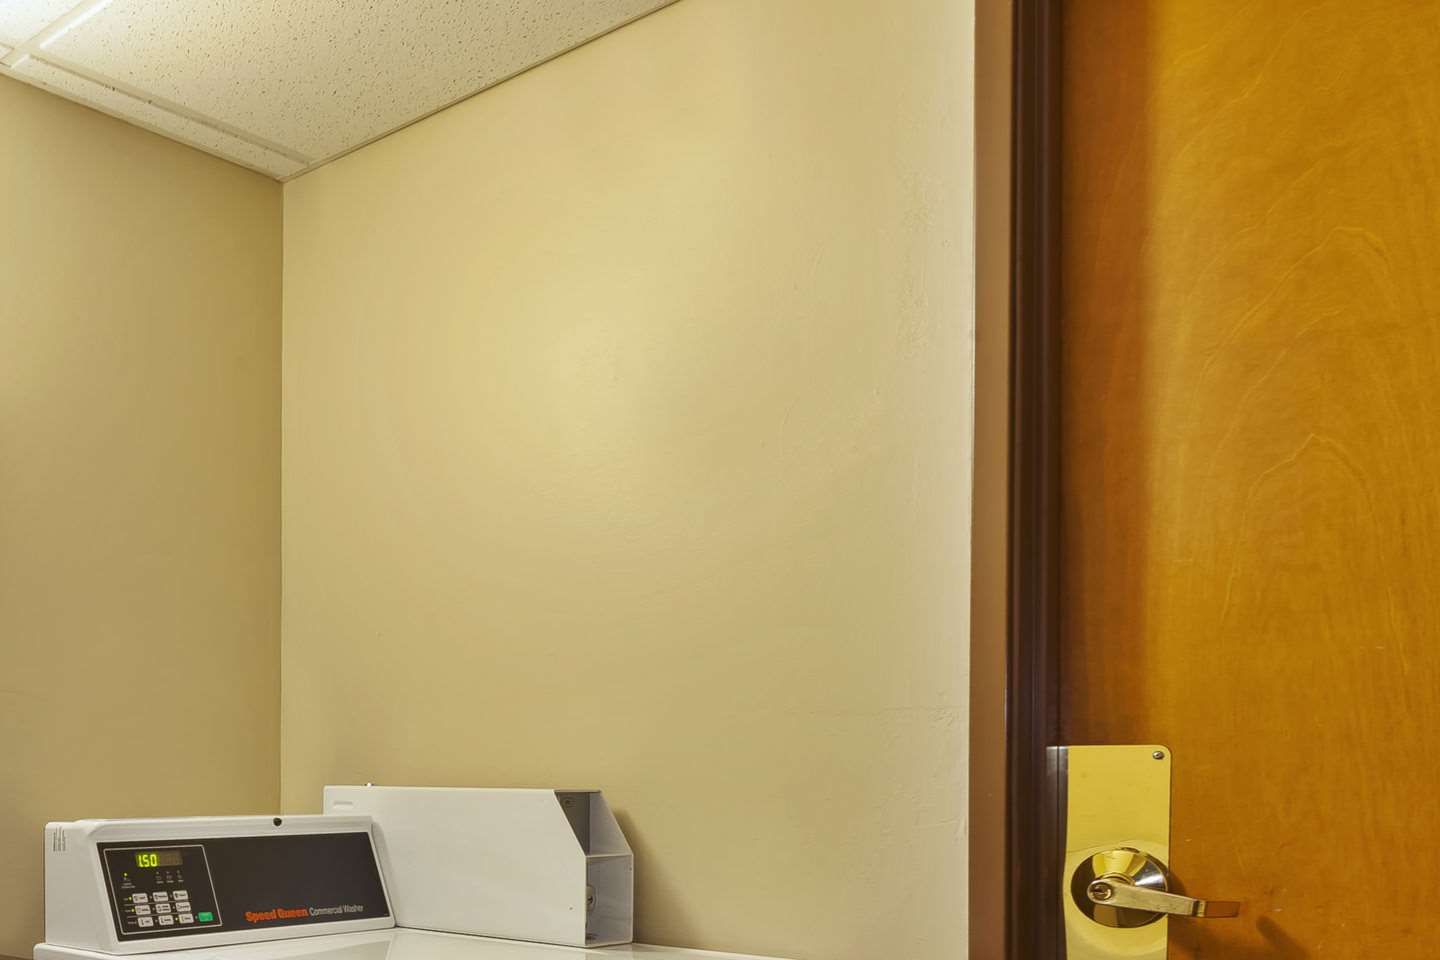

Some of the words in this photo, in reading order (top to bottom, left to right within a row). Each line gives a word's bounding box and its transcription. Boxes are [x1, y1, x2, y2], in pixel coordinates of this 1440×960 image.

[245, 909, 277, 923] Speed
[277, 906, 309, 919] Queen
[309, 905, 342, 917] Commercial
[343, 904, 364, 914] Washer
